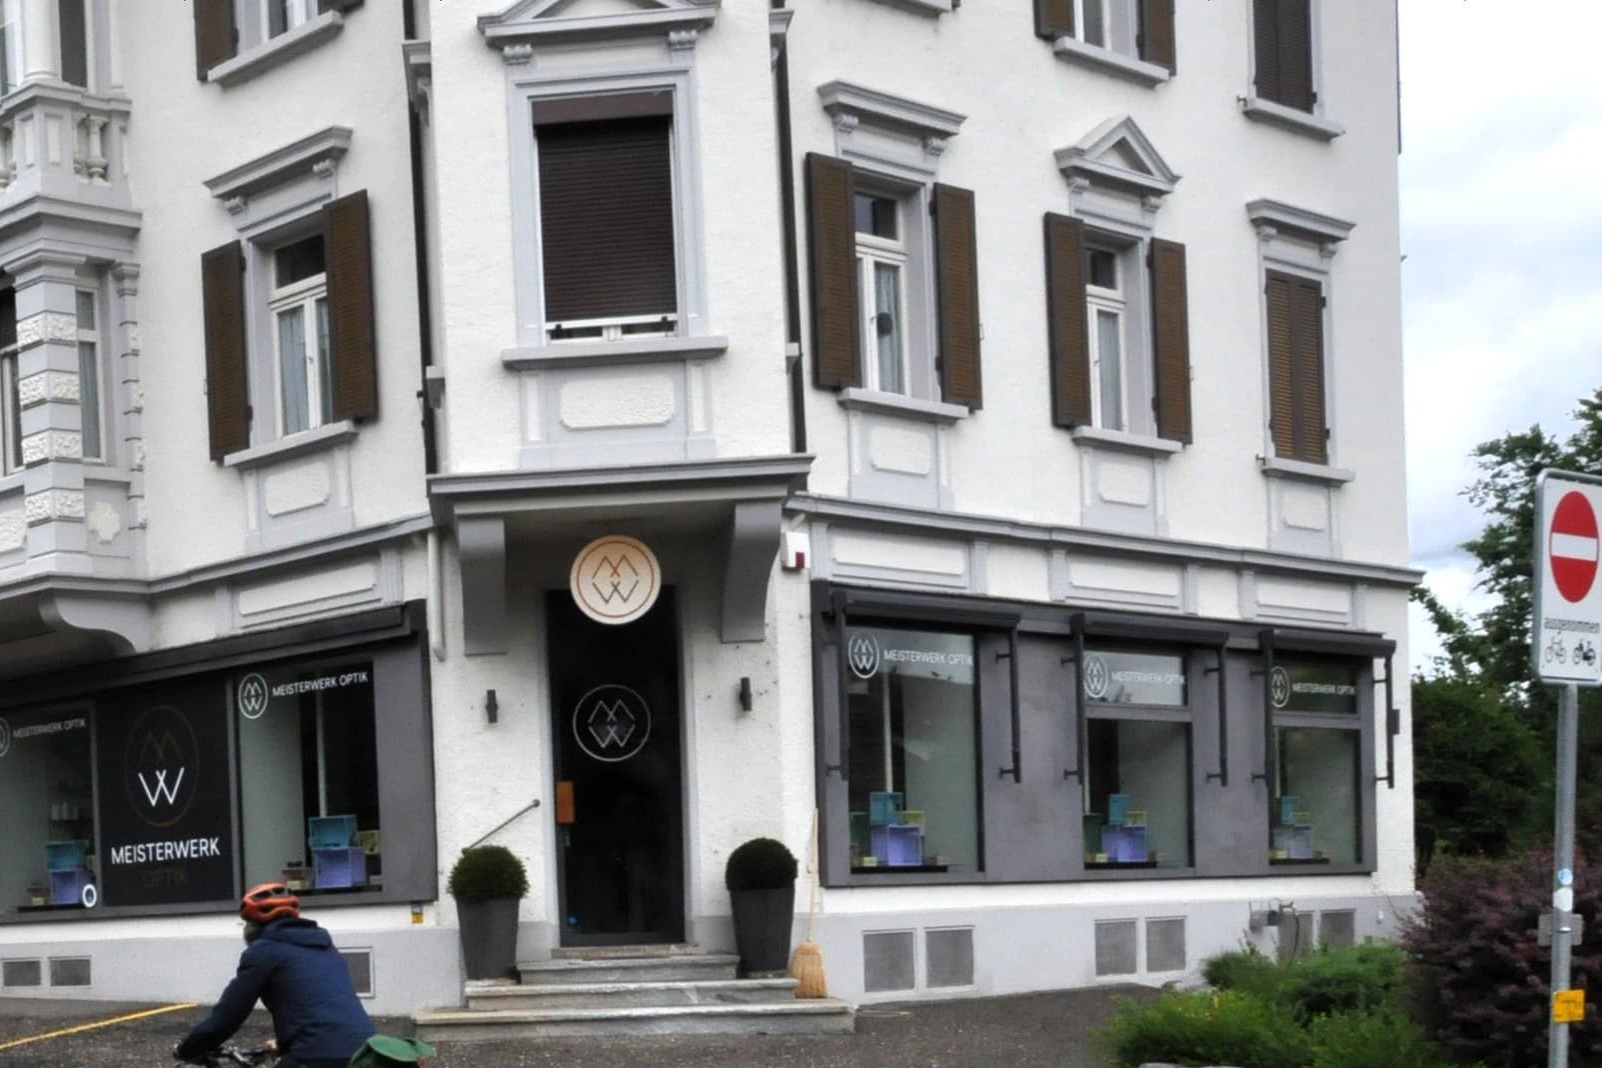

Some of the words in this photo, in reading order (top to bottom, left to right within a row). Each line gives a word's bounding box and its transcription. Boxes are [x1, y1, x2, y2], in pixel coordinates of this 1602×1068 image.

[884, 649, 946, 664] MEISTERWERK
[272, 676, 337, 697] MEISTERWERK
[339, 672, 368, 686] OPTIK
[111, 837, 221, 865] MEISTERWERK
